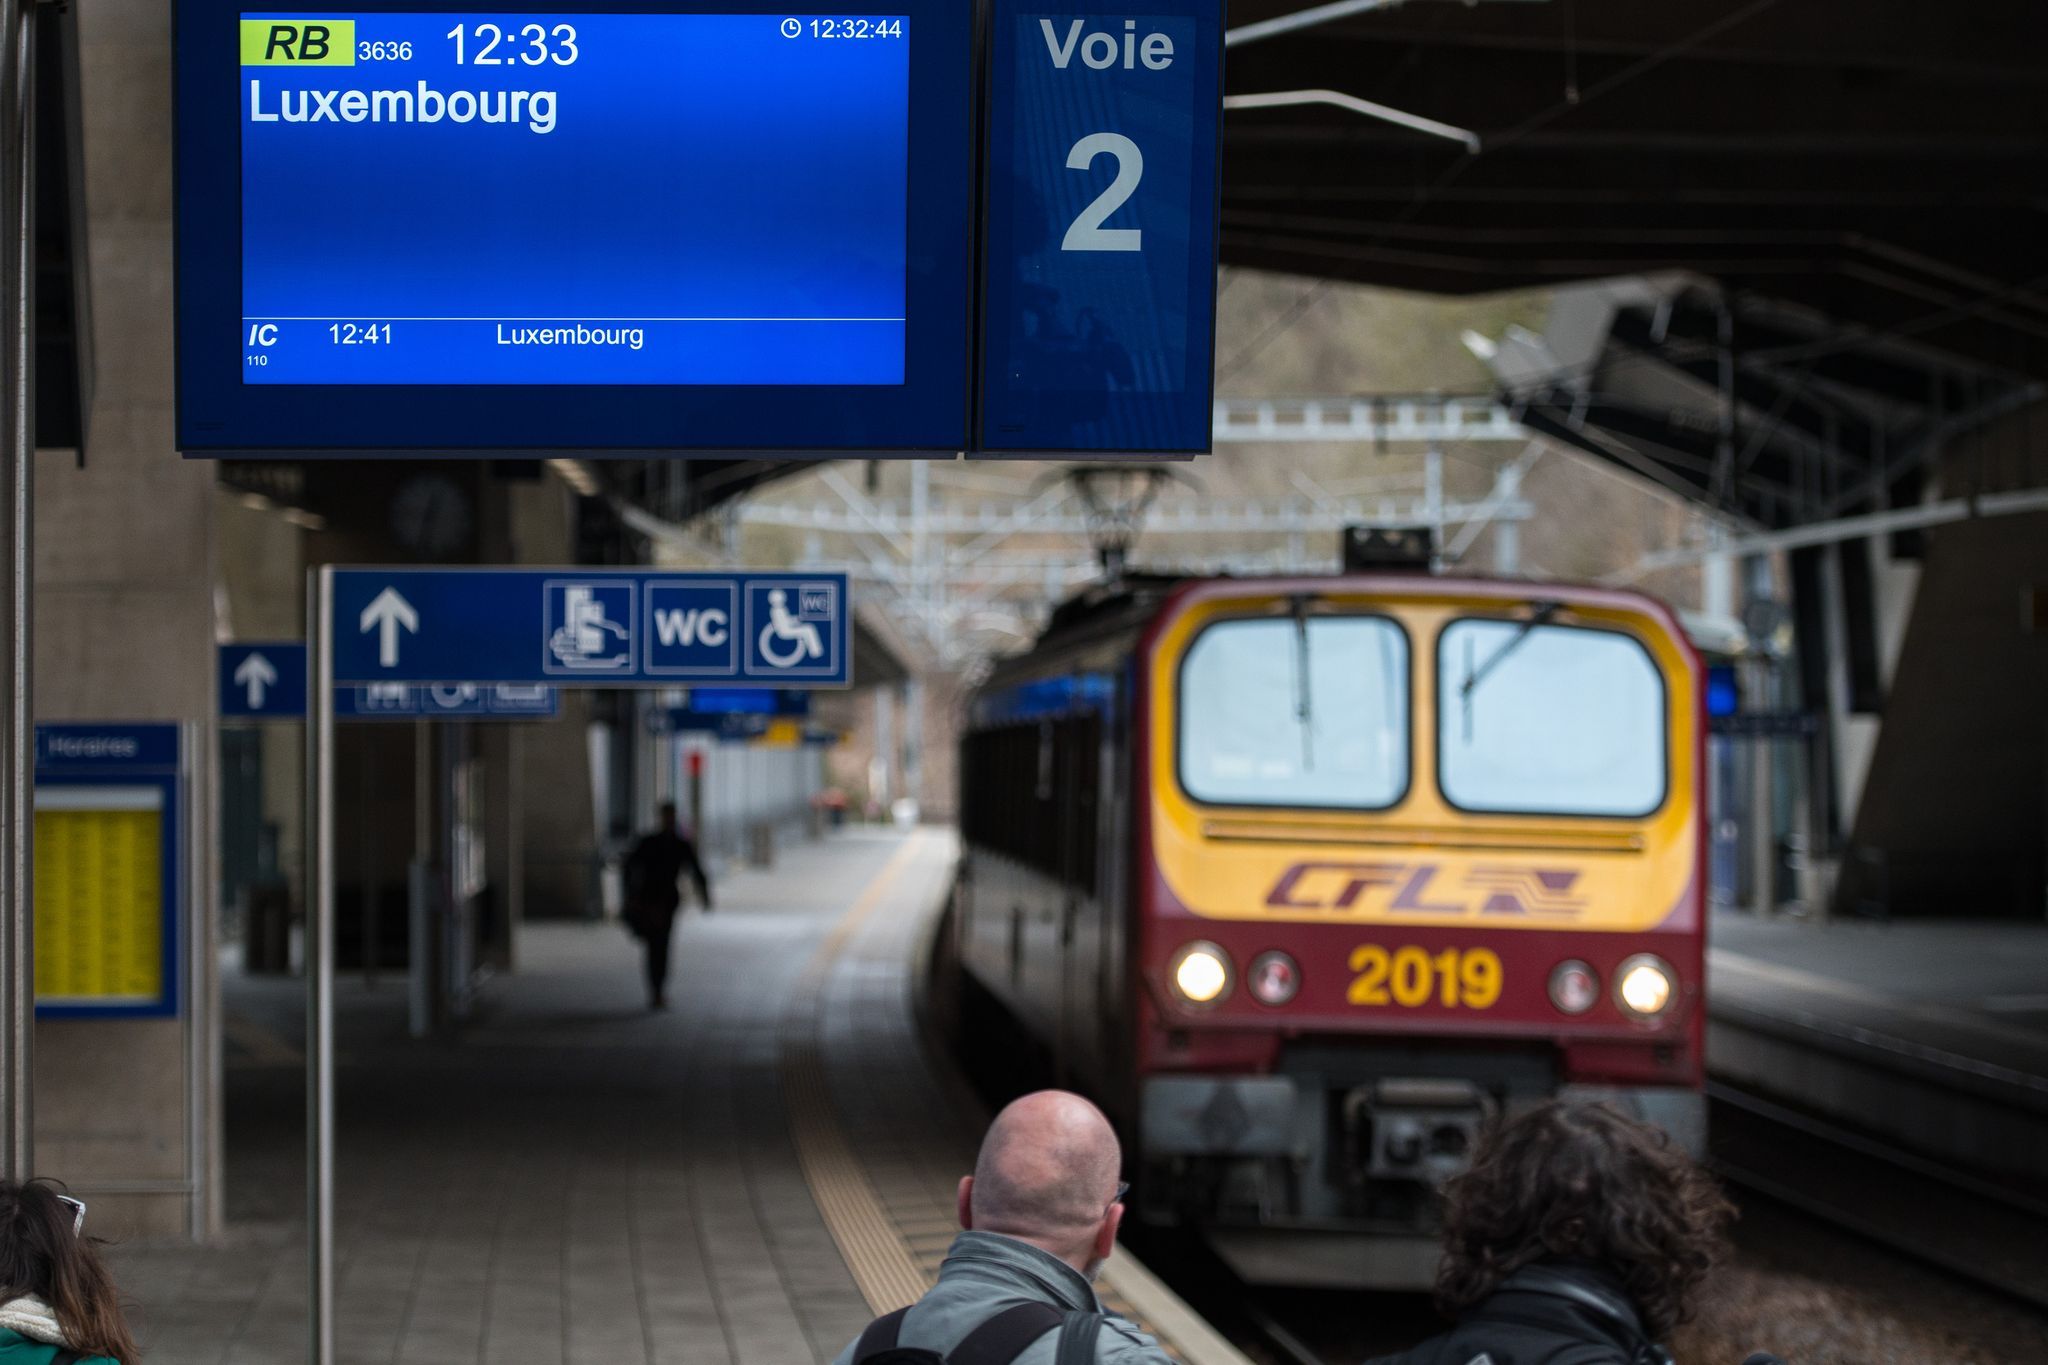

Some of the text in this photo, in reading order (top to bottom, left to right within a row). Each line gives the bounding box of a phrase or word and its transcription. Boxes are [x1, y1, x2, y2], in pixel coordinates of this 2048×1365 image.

[265, 24, 579, 66] RB 3636 12:33
[809, 19, 902, 38] 12:32:44
[1039, 19, 1175, 70] Voie
[250, 80, 557, 134] Luxembourg
[1060, 132, 1144, 251] 2
[248, 323, 644, 349] IC 12:41 Luxembourg
[246, 355, 268, 366] 110
[654, 607, 729, 646] WC
[1265, 861, 1468, 912] CFL
[1346, 943, 1503, 1009] 2019
